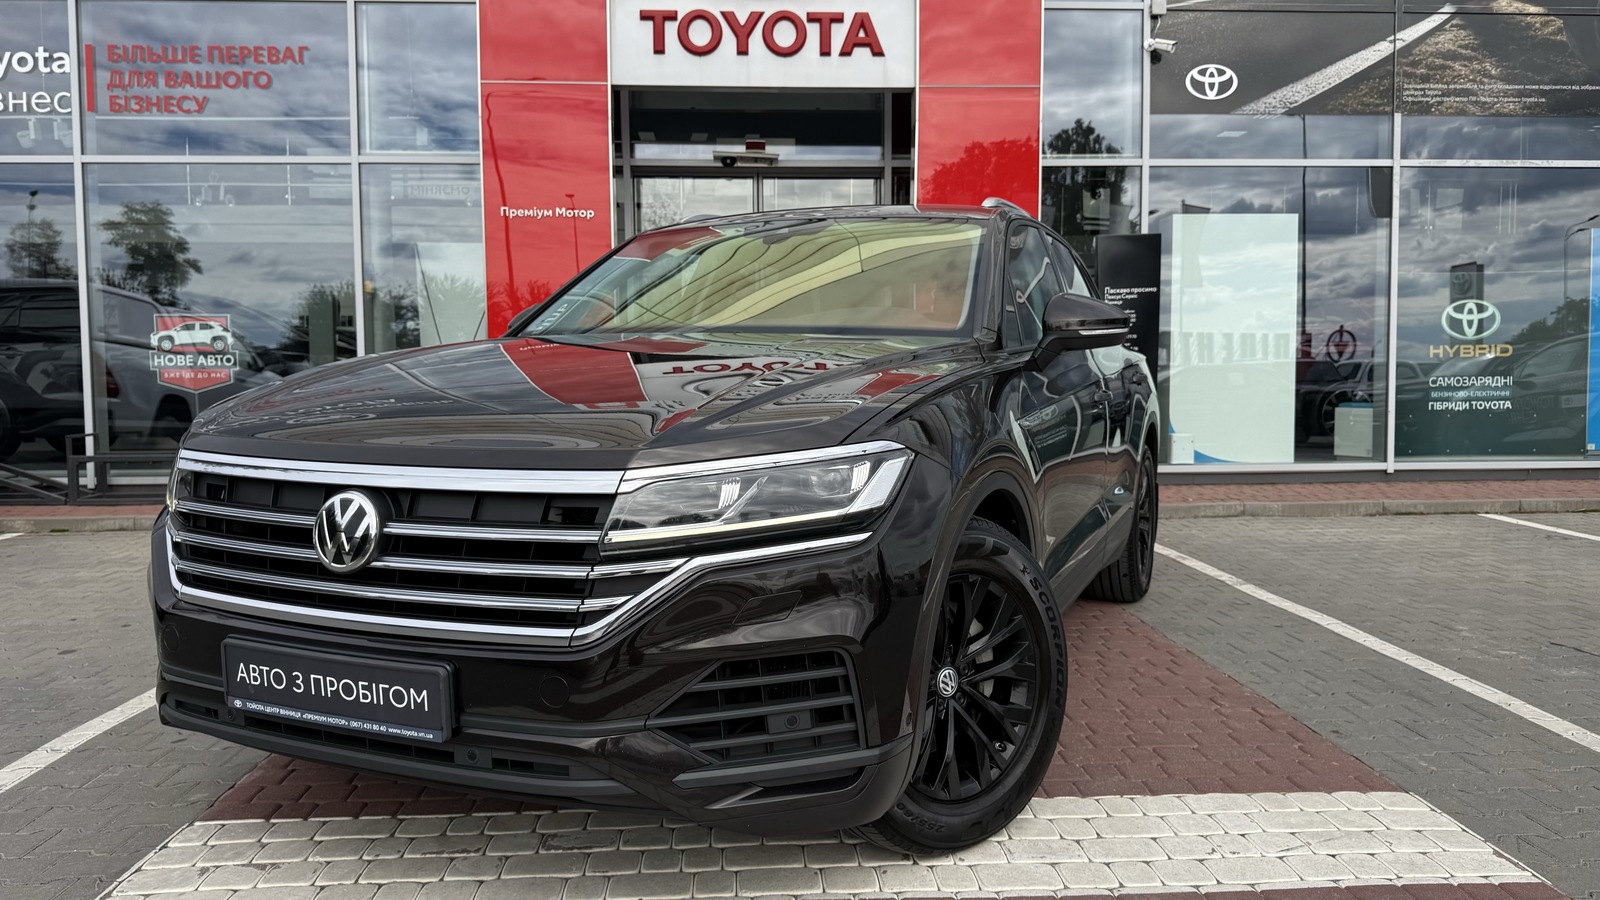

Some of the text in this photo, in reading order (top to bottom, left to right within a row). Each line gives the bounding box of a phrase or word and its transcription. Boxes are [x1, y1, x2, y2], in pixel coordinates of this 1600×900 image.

[639, 9, 886, 57] TOYOTA
[107, 45, 309, 65] БІЛЬШЕ ПЕРЕВАГ
[107, 70, 272, 91] ДЛЯ ВАШОГО
[109, 95, 207, 114] БІЗНЕСУ
[500, 206, 595, 220] Преміум Мотор
[154, 354, 234, 366] НОВЕ АВТО
[1429, 344, 1513, 358] HYBRID
[1428, 375, 1513, 387] САМОЗАРЯДНІ
[1428, 400, 1512, 411] ГІБРИДИ TOYOTA
[1029, 576, 1067, 711] SCORPION
[236, 662, 429, 712] АВТО З ПРОБІГОМ
[246, 702, 264, 711] ТОЙОТА
[264, 706, 280, 714] ЦЕНТР
[280, 708, 301, 718] ВІННИЦЯ
[349, 720, 363, 729] (067)
[363, 722, 372, 730] 431
